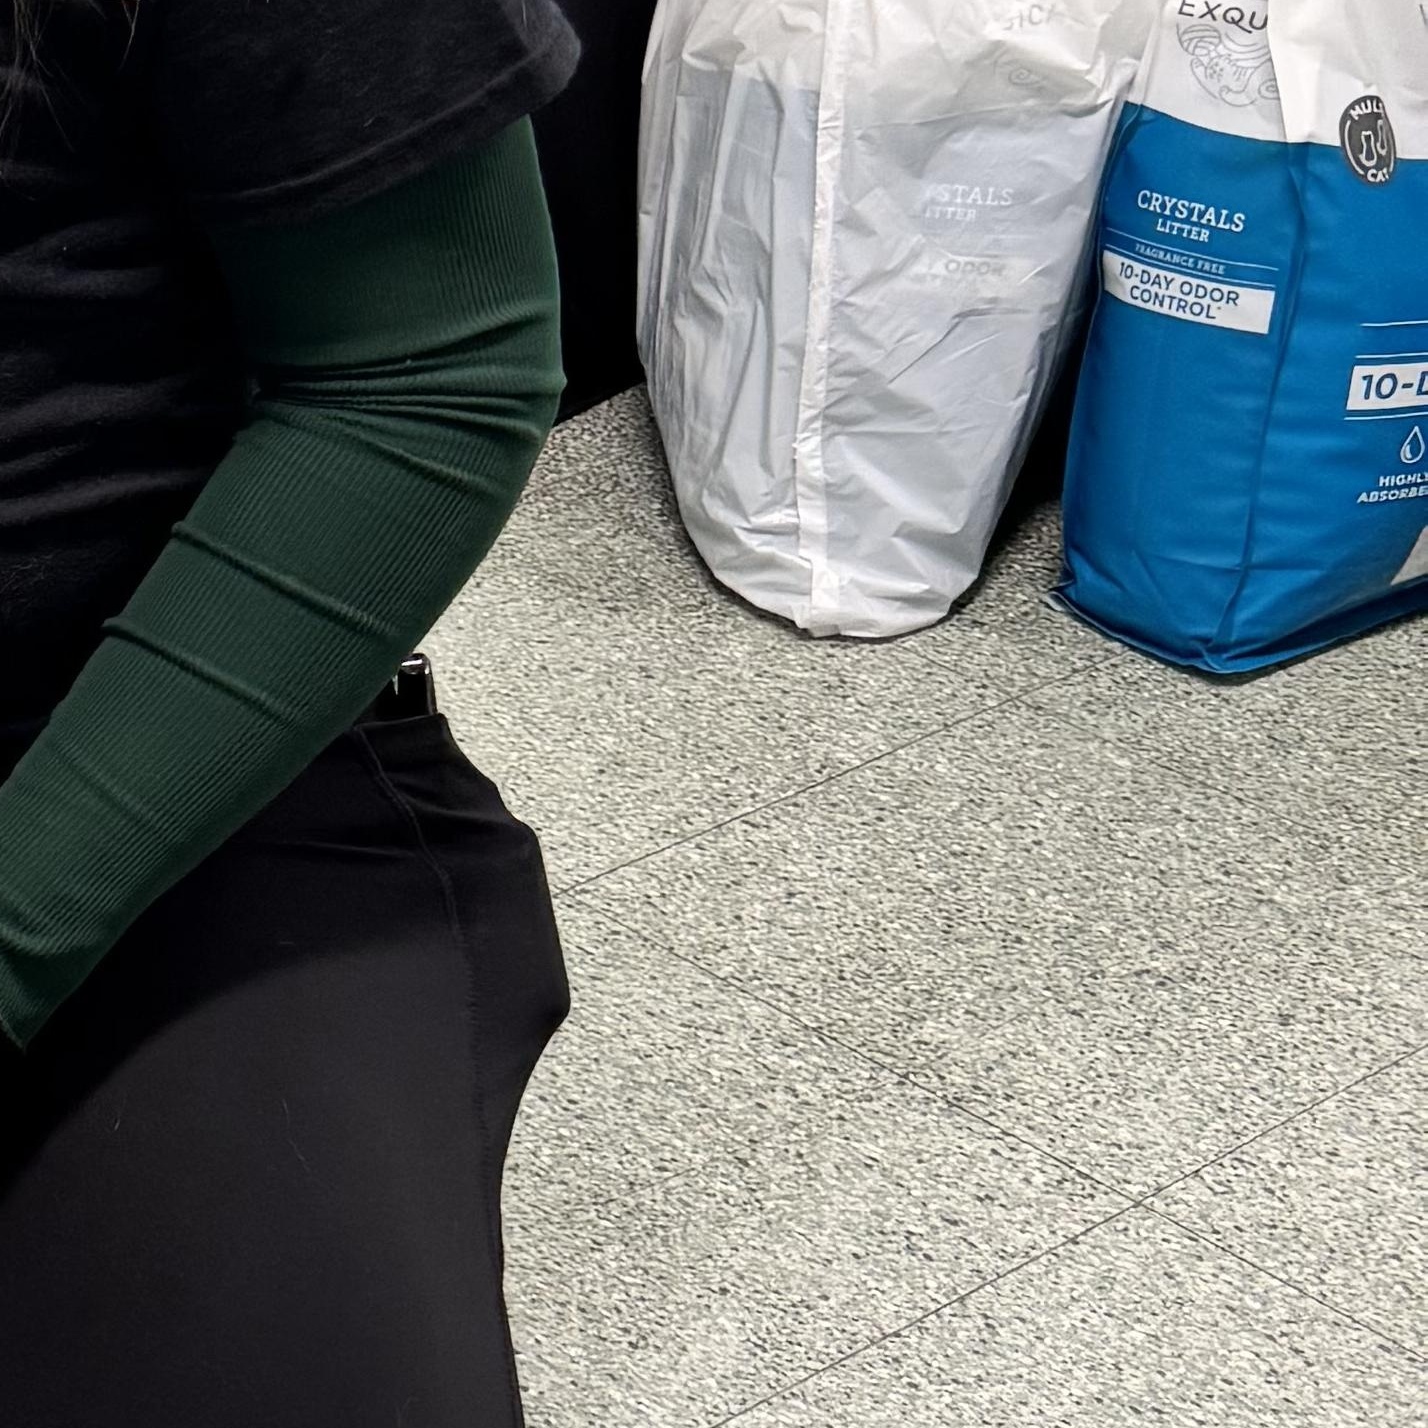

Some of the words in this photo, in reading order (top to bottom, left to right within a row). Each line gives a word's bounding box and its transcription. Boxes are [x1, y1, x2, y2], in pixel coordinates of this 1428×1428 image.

[924, 183, 1015, 206] STALS
[1137, 189, 1246, 233] CRYSTALS
[1156, 218, 1211, 243] LITTER
[1135, 243, 1194, 269] FRAGRANCE
[1197, 259, 1227, 275] FREE
[1119, 261, 1176, 291] 10-DAY
[1179, 281, 1240, 307] ODOR
